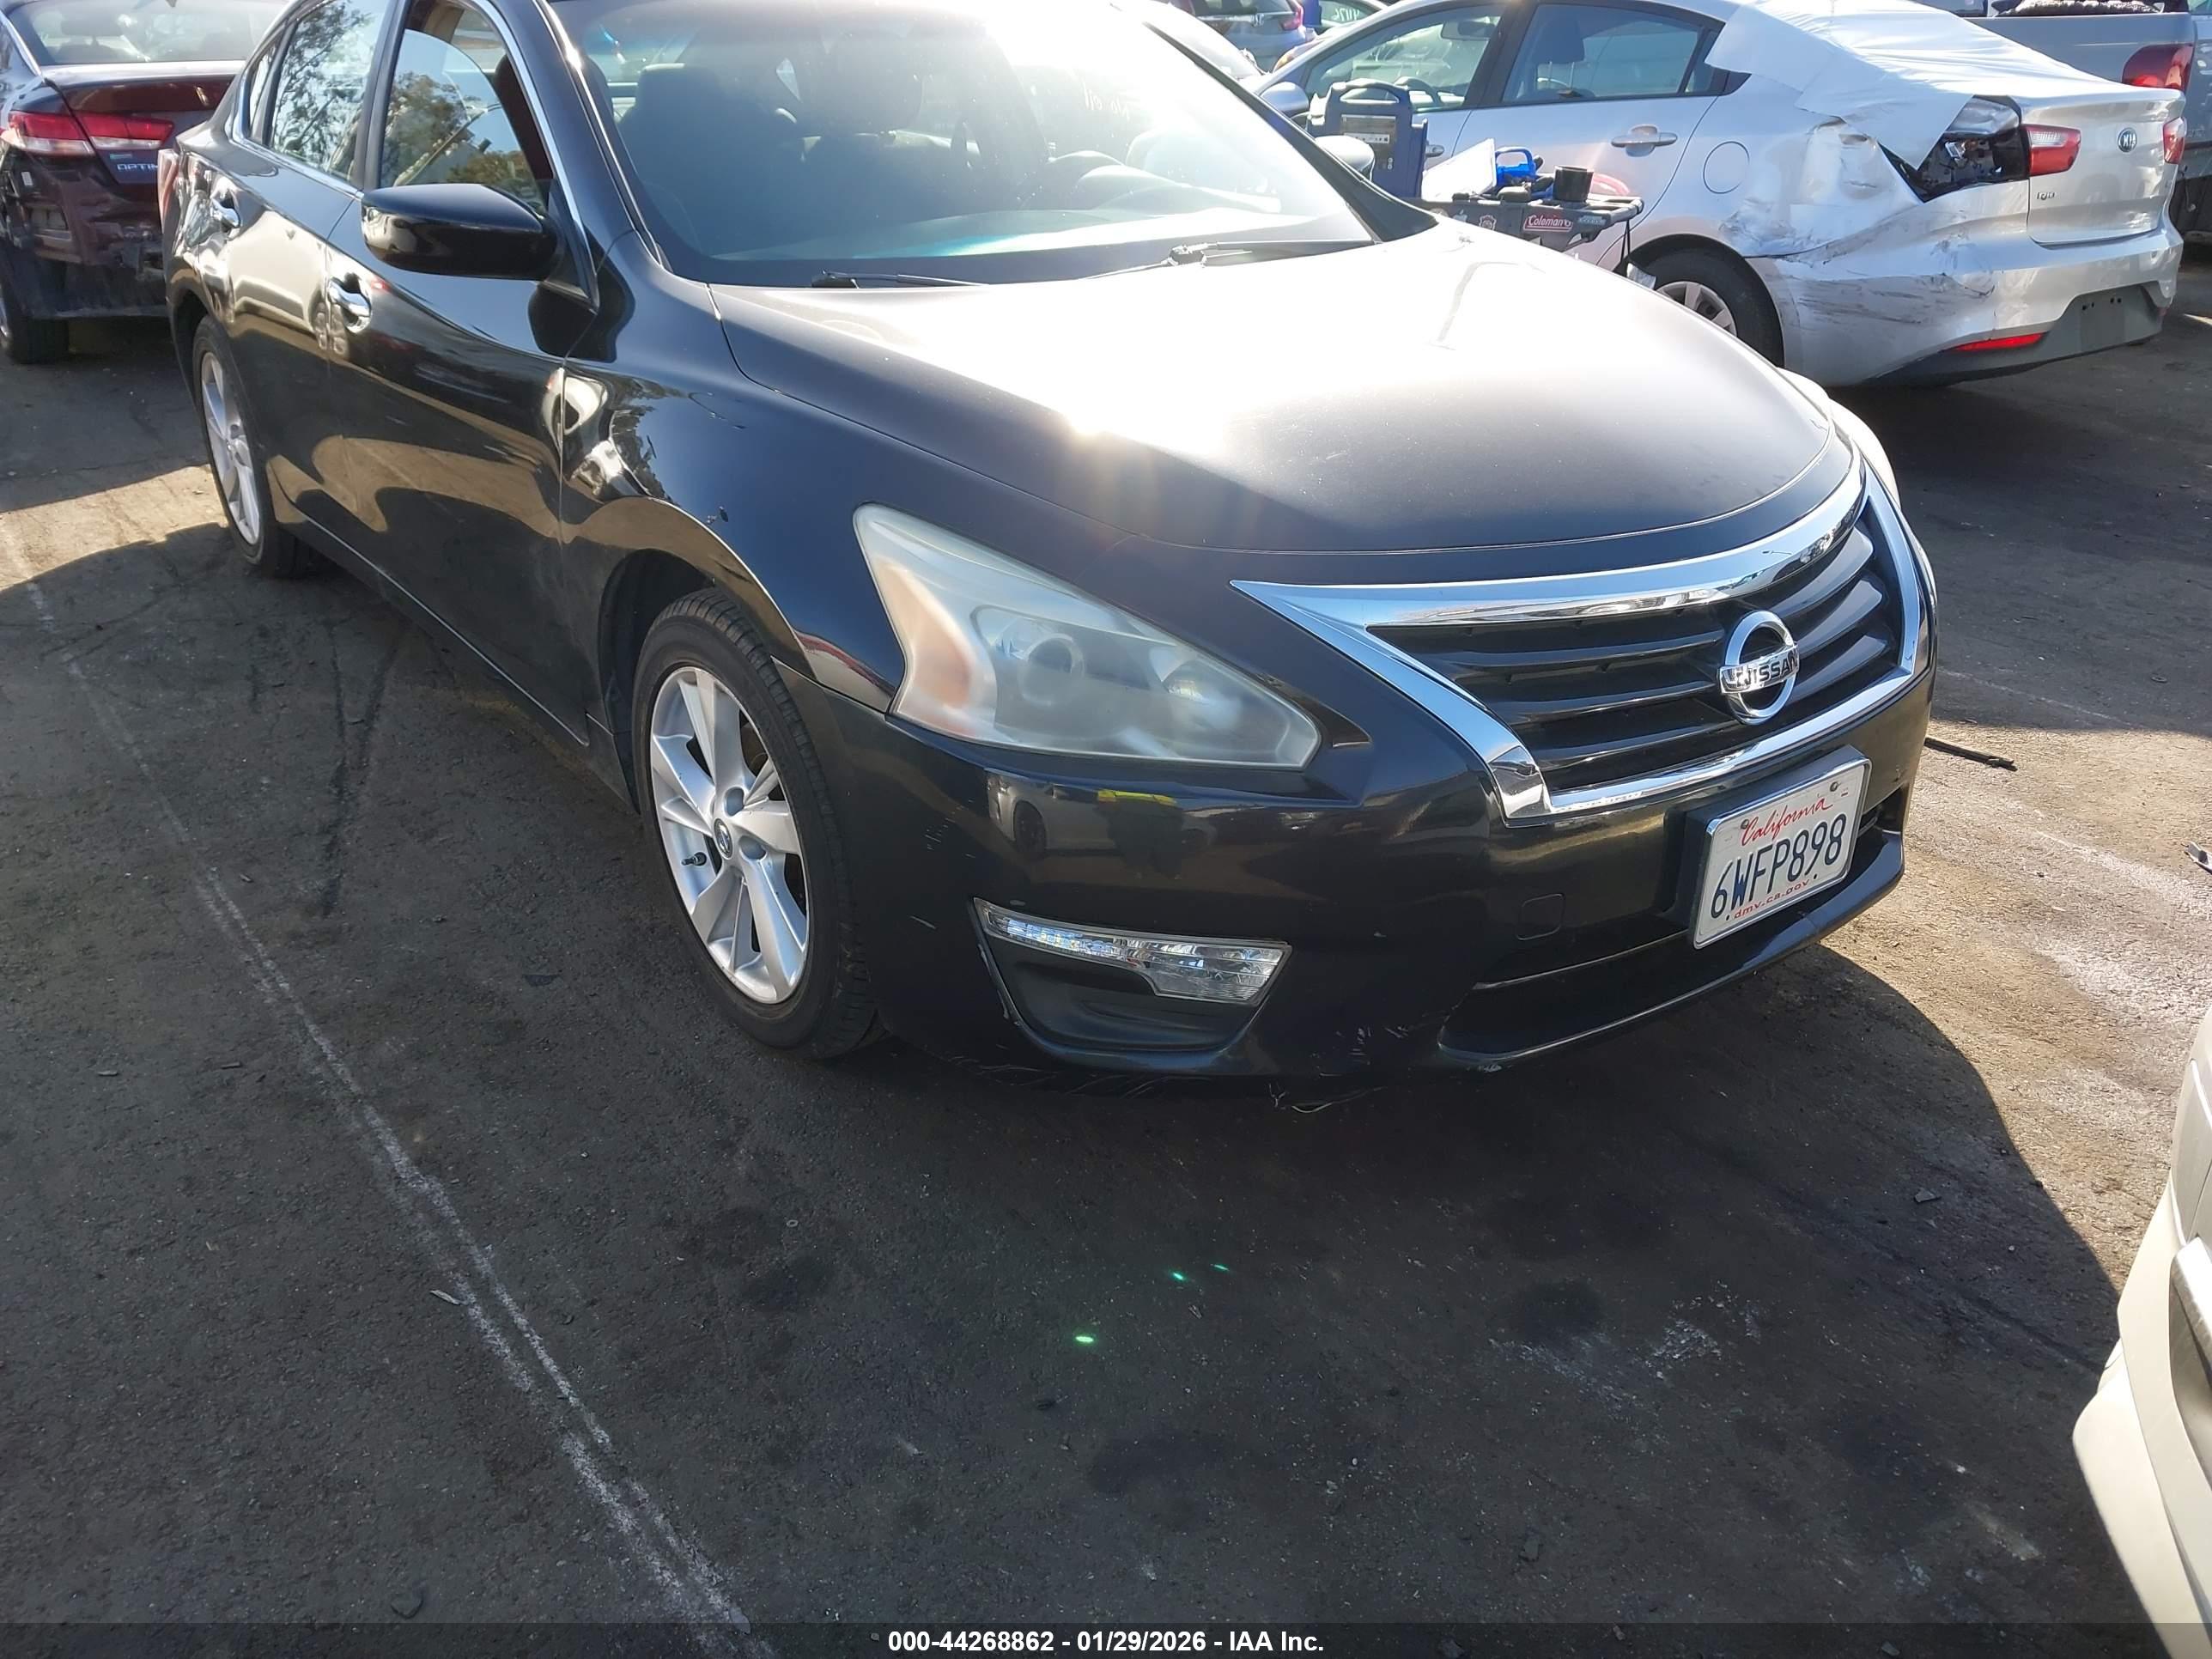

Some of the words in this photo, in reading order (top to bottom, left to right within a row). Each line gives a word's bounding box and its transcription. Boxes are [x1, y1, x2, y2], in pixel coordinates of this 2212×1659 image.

[2122, 131, 2136, 147] KIA
[1528, 214, 1564, 227] Coleman
[1735, 648, 1798, 688] NISSAN
[1741, 796, 1833, 846] California
[1711, 813, 1847, 919] 6WFP898
[1734, 878, 1810, 919] dmv.ca.gov
